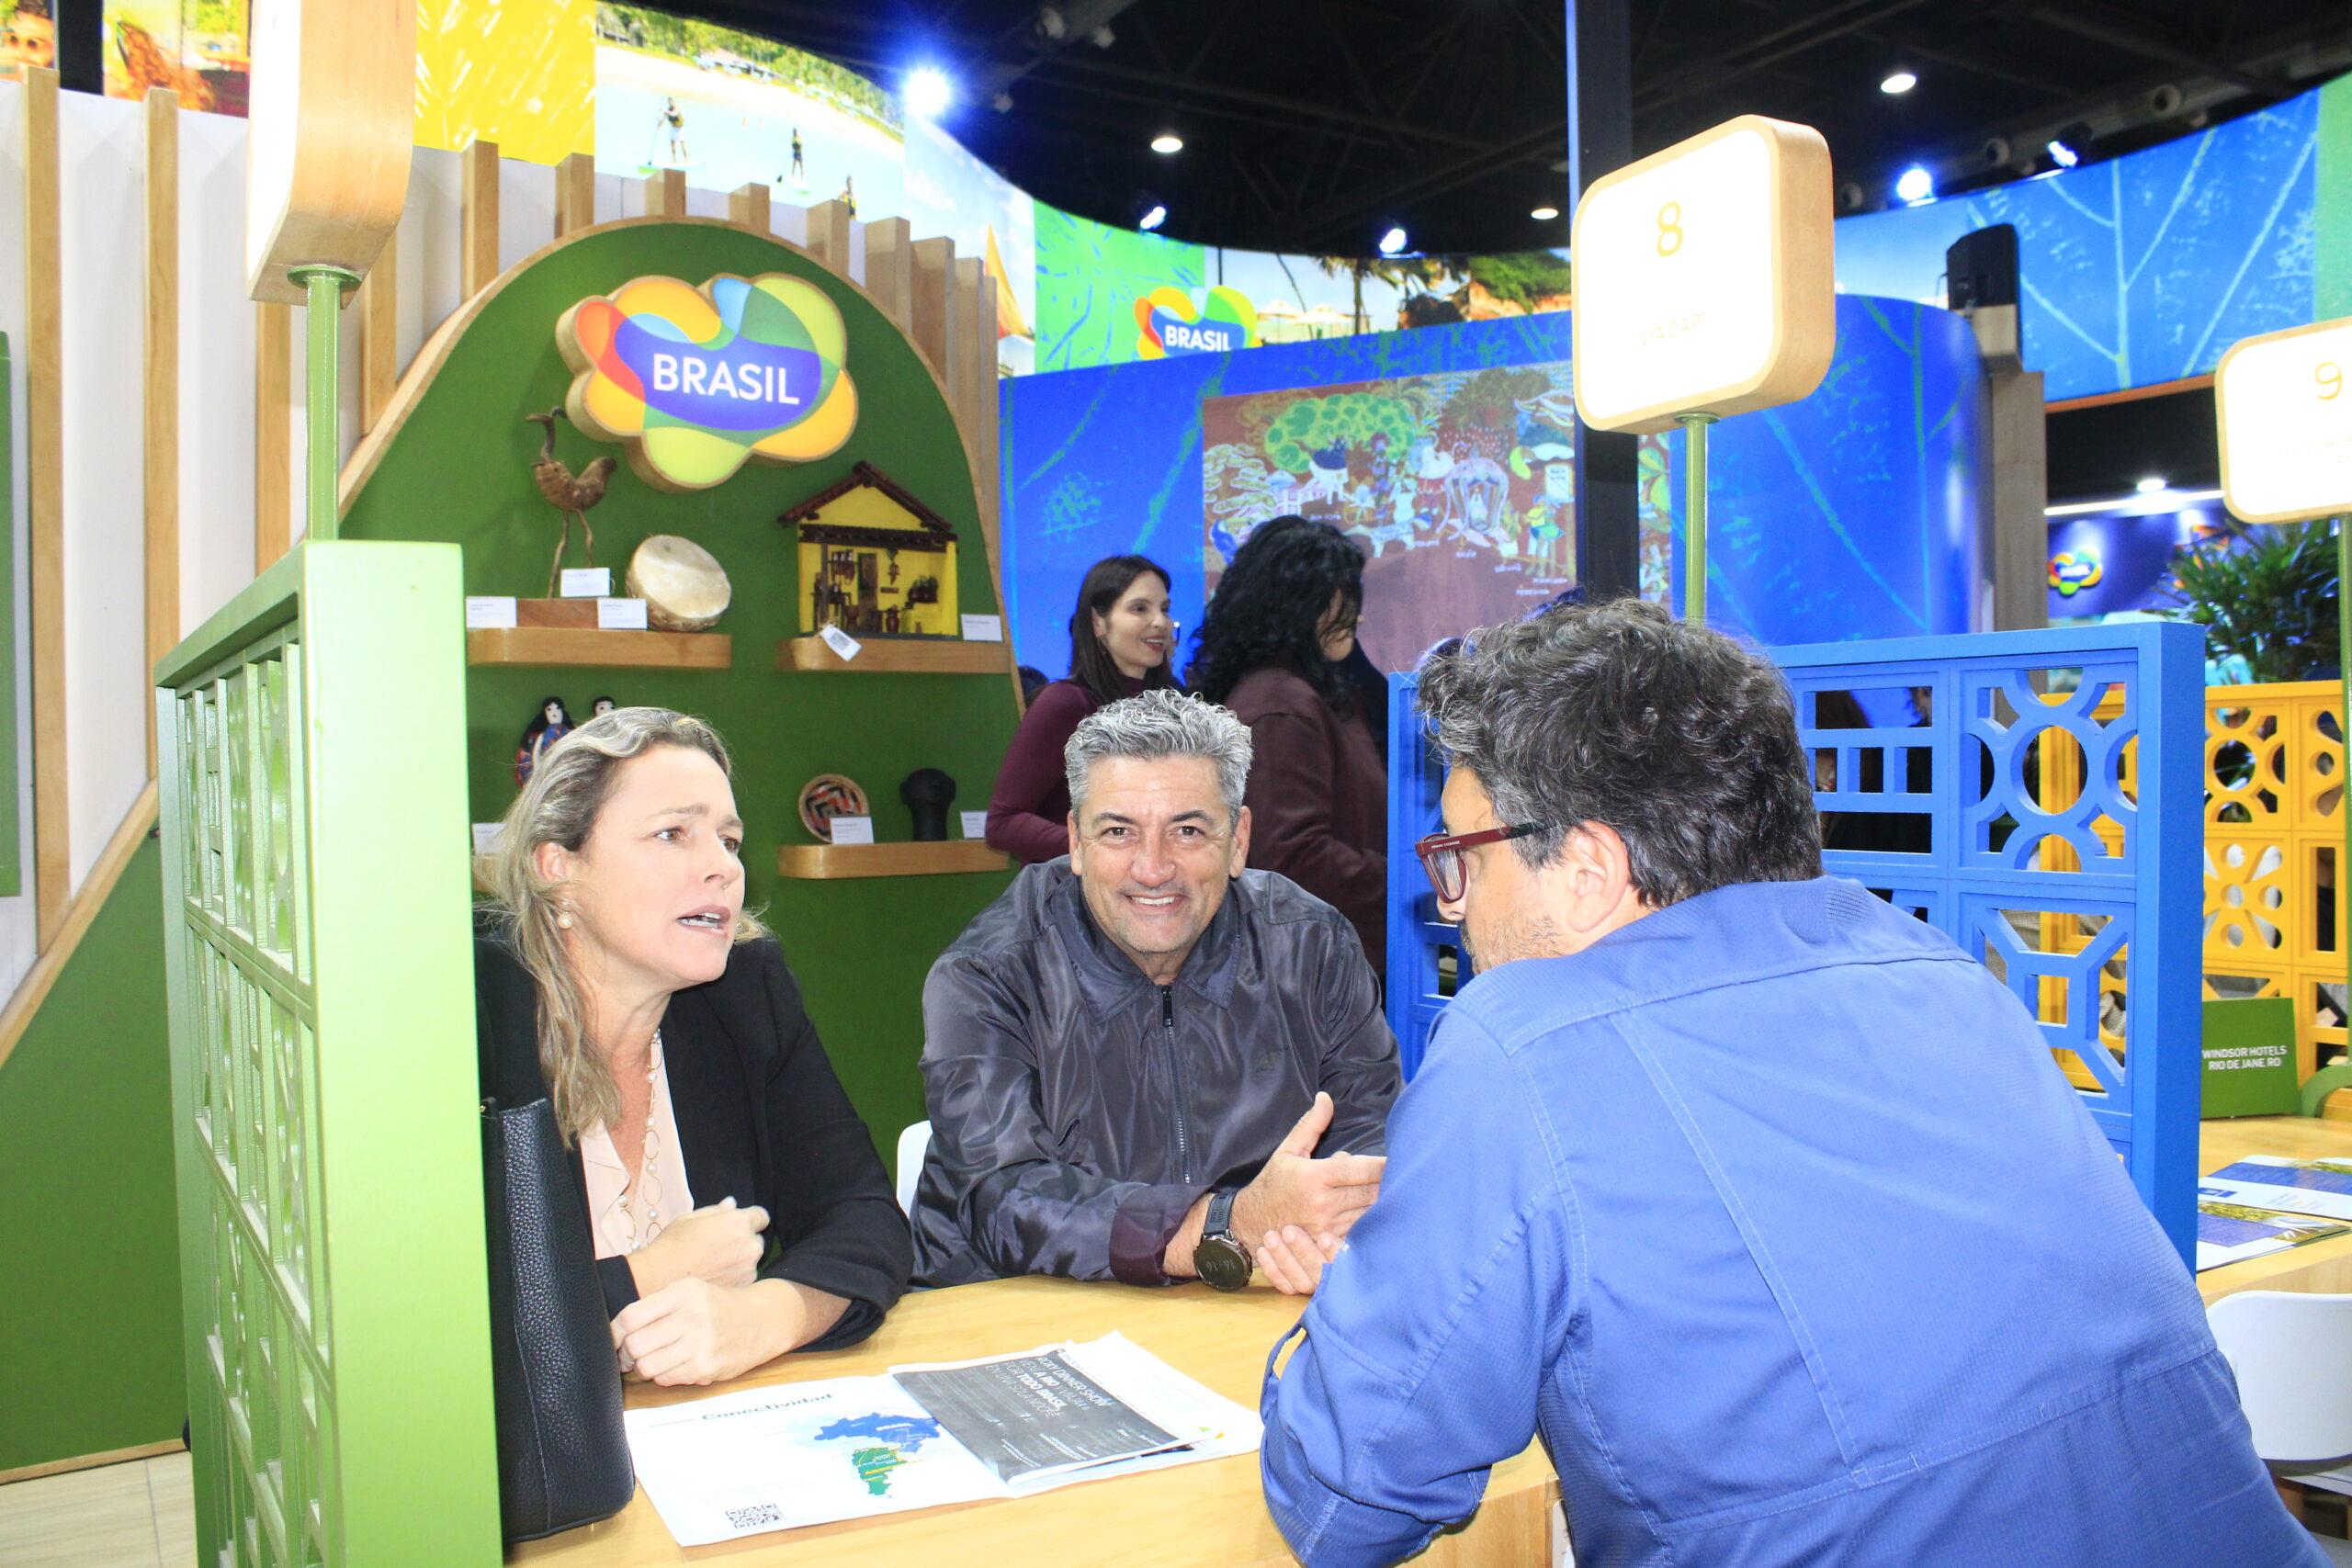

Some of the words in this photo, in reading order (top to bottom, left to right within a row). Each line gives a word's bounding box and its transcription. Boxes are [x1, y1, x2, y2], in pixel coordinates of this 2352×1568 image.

[1657, 201, 1683, 257] 8
[1165, 324, 1230, 353] BRASIL
[653, 353, 799, 405] BRASIL
[2315, 362, 2343, 400] 9
[2202, 1047, 2248, 1059] WINDSOR
[2249, 1045, 2288, 1056] HOTELS
[2209, 1060, 2225, 1071] RIO
[2226, 1059, 2241, 1069] DE
[1015, 1372, 1045, 1390] TODO
[1052, 1369, 1088, 1391] DINNER
[1079, 1388, 1113, 1407] SHOW
[702, 1393, 831, 1420] Conectividad
